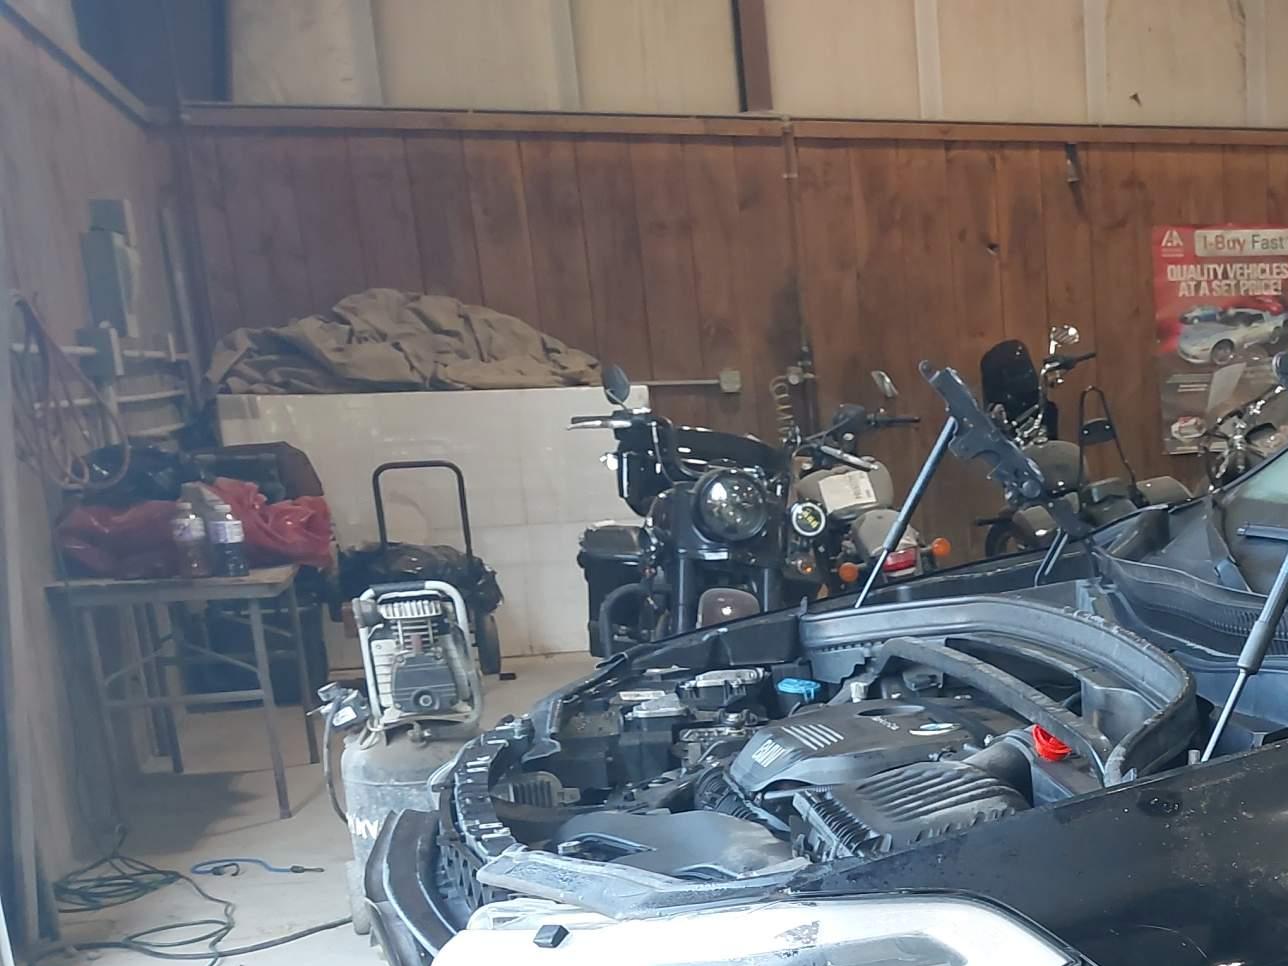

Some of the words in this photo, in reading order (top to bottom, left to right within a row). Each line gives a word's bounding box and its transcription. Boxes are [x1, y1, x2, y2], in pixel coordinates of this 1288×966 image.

[1203, 235, 1247, 253] I-Buy
[1251, 234, 1285, 250] Fast
[1167, 264, 1226, 282] QUALITY
[1178, 281, 1197, 297] AT
[1198, 281, 1210, 297] A
[1213, 280, 1239, 297] SET
